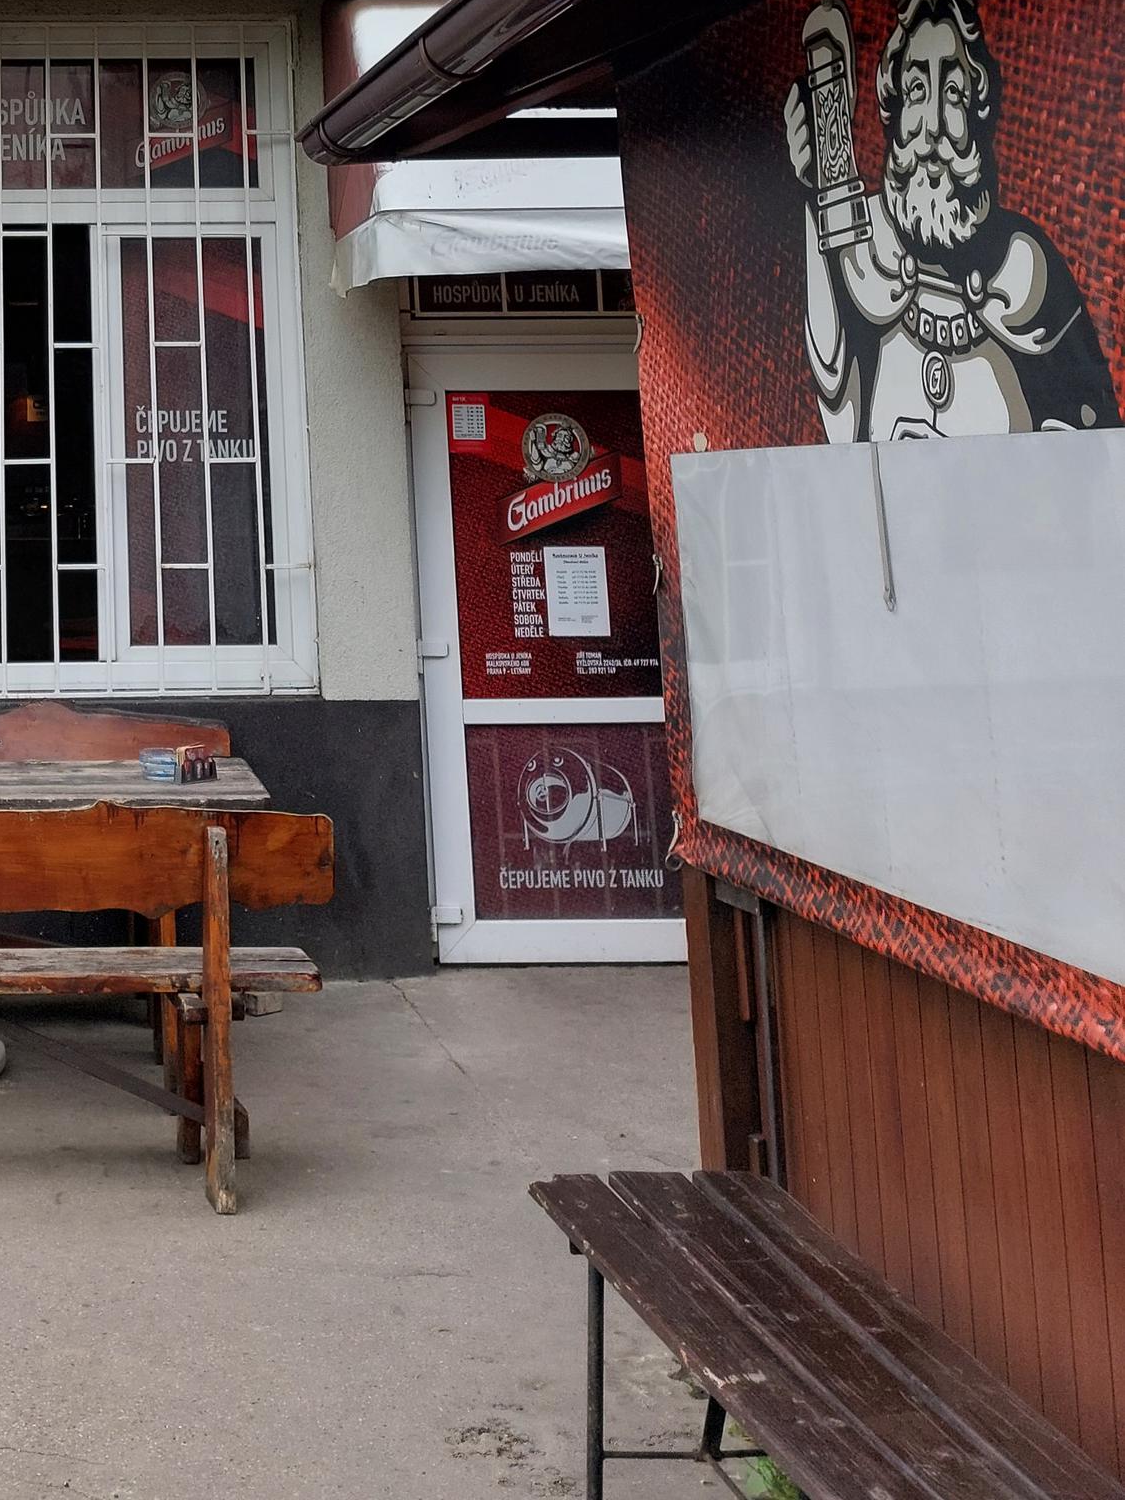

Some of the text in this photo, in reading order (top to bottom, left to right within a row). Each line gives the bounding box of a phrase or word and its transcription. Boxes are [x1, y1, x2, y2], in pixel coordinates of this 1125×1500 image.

[135, 115, 225, 169] Gambrnus
[514, 285, 525, 303] U
[528, 281, 580, 303] JENÍKA
[183, 440, 193, 462] Z
[507, 468, 612, 532] Gambrinus
[510, 550, 543, 563] PONDĚLÍ
[511, 563, 535, 575] ÚTERÝ
[512, 575, 541, 587] STŘEDA
[512, 587, 546, 600] ČTVRTEK
[513, 600, 537, 613] PÁTEK
[514, 614, 543, 625] SOBOTA
[515, 626, 544, 638] NEDĚLE
[499, 867, 571, 889] ČEPUJEME
[575, 870, 605, 888] PIVO
[620, 869, 664, 888] TANKU
